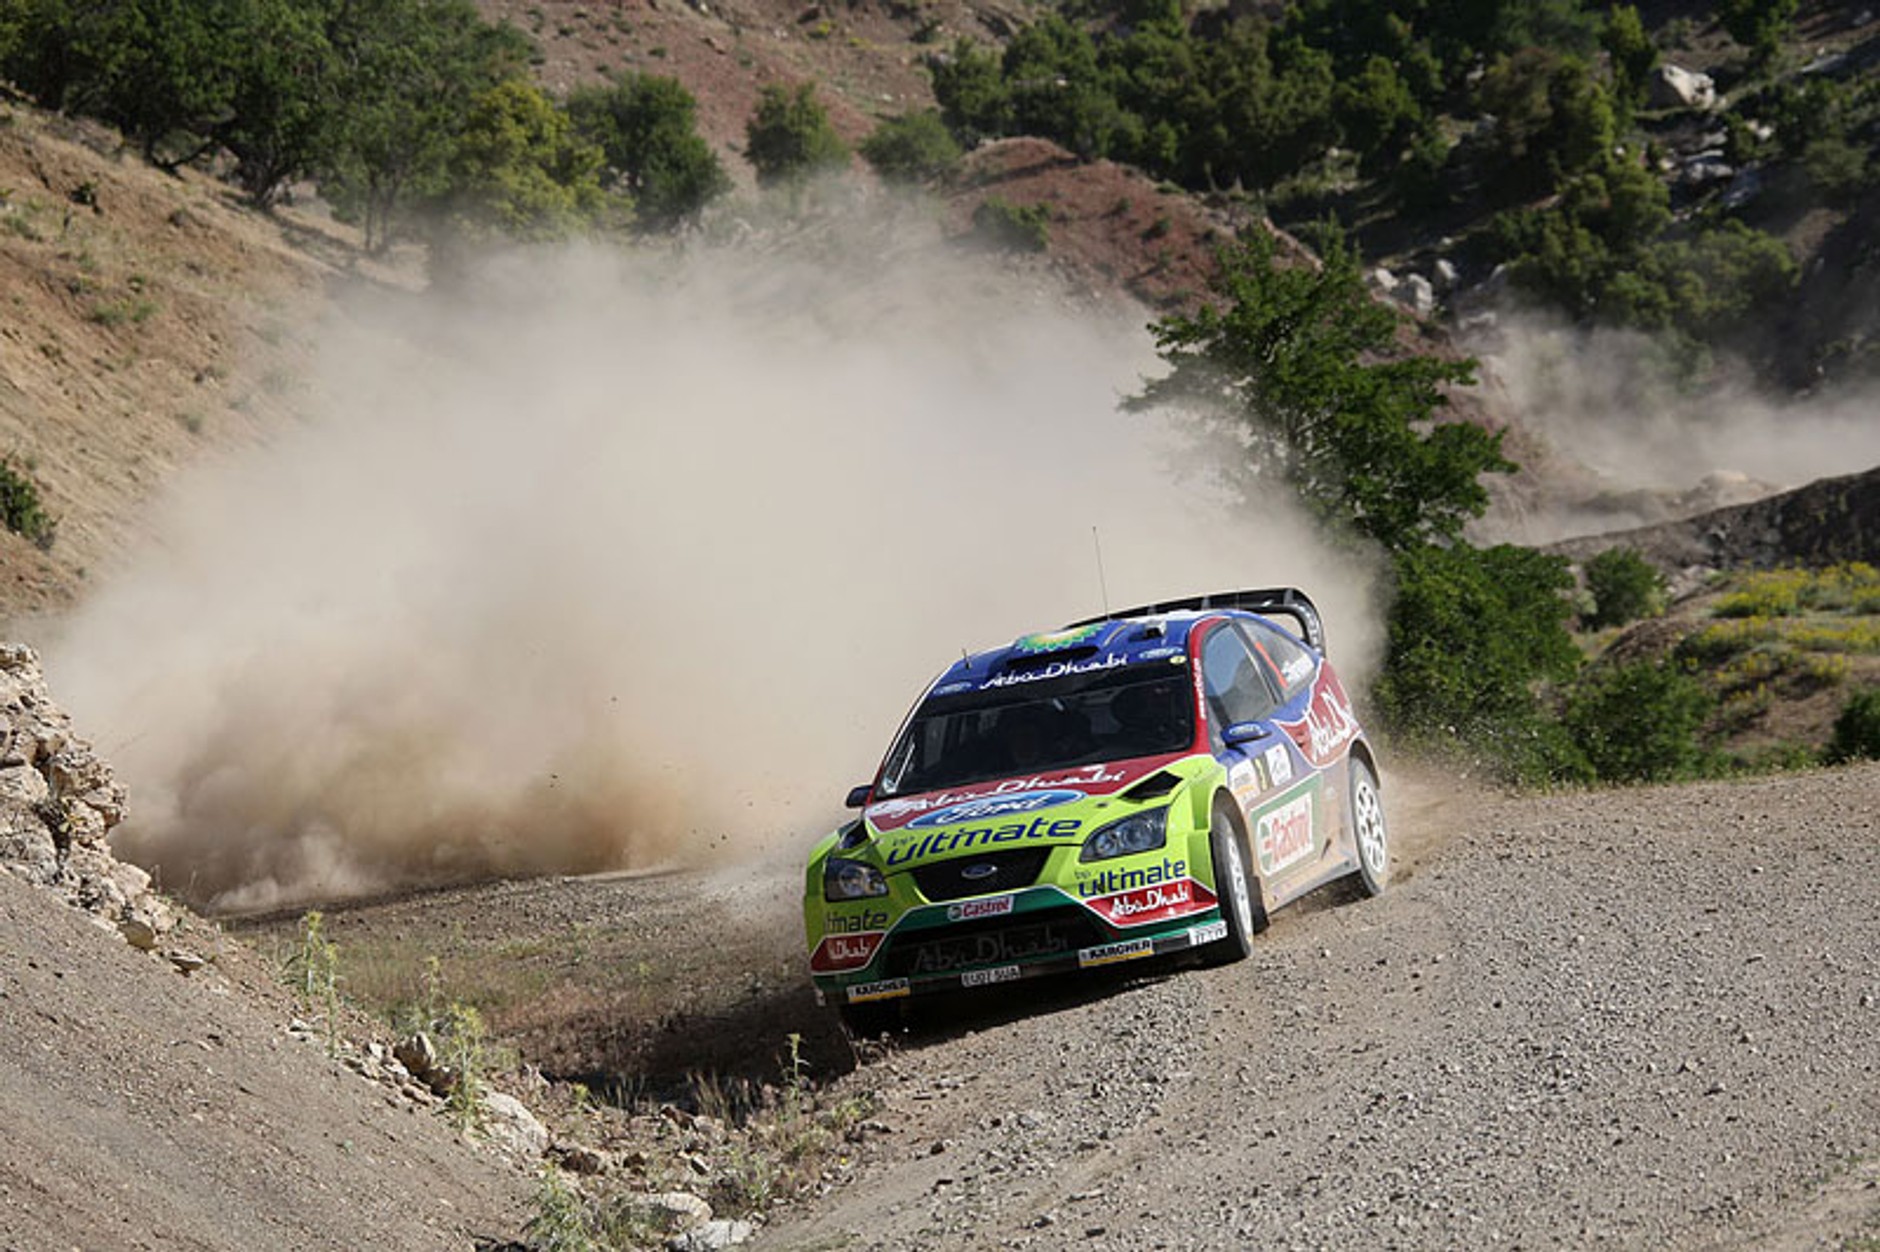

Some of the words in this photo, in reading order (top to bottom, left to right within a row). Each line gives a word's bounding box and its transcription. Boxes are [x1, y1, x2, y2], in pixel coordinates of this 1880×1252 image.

[887, 817, 1082, 865] ultimate
[1078, 857, 1186, 897] ultimate
[963, 897, 1011, 917] Castrol
